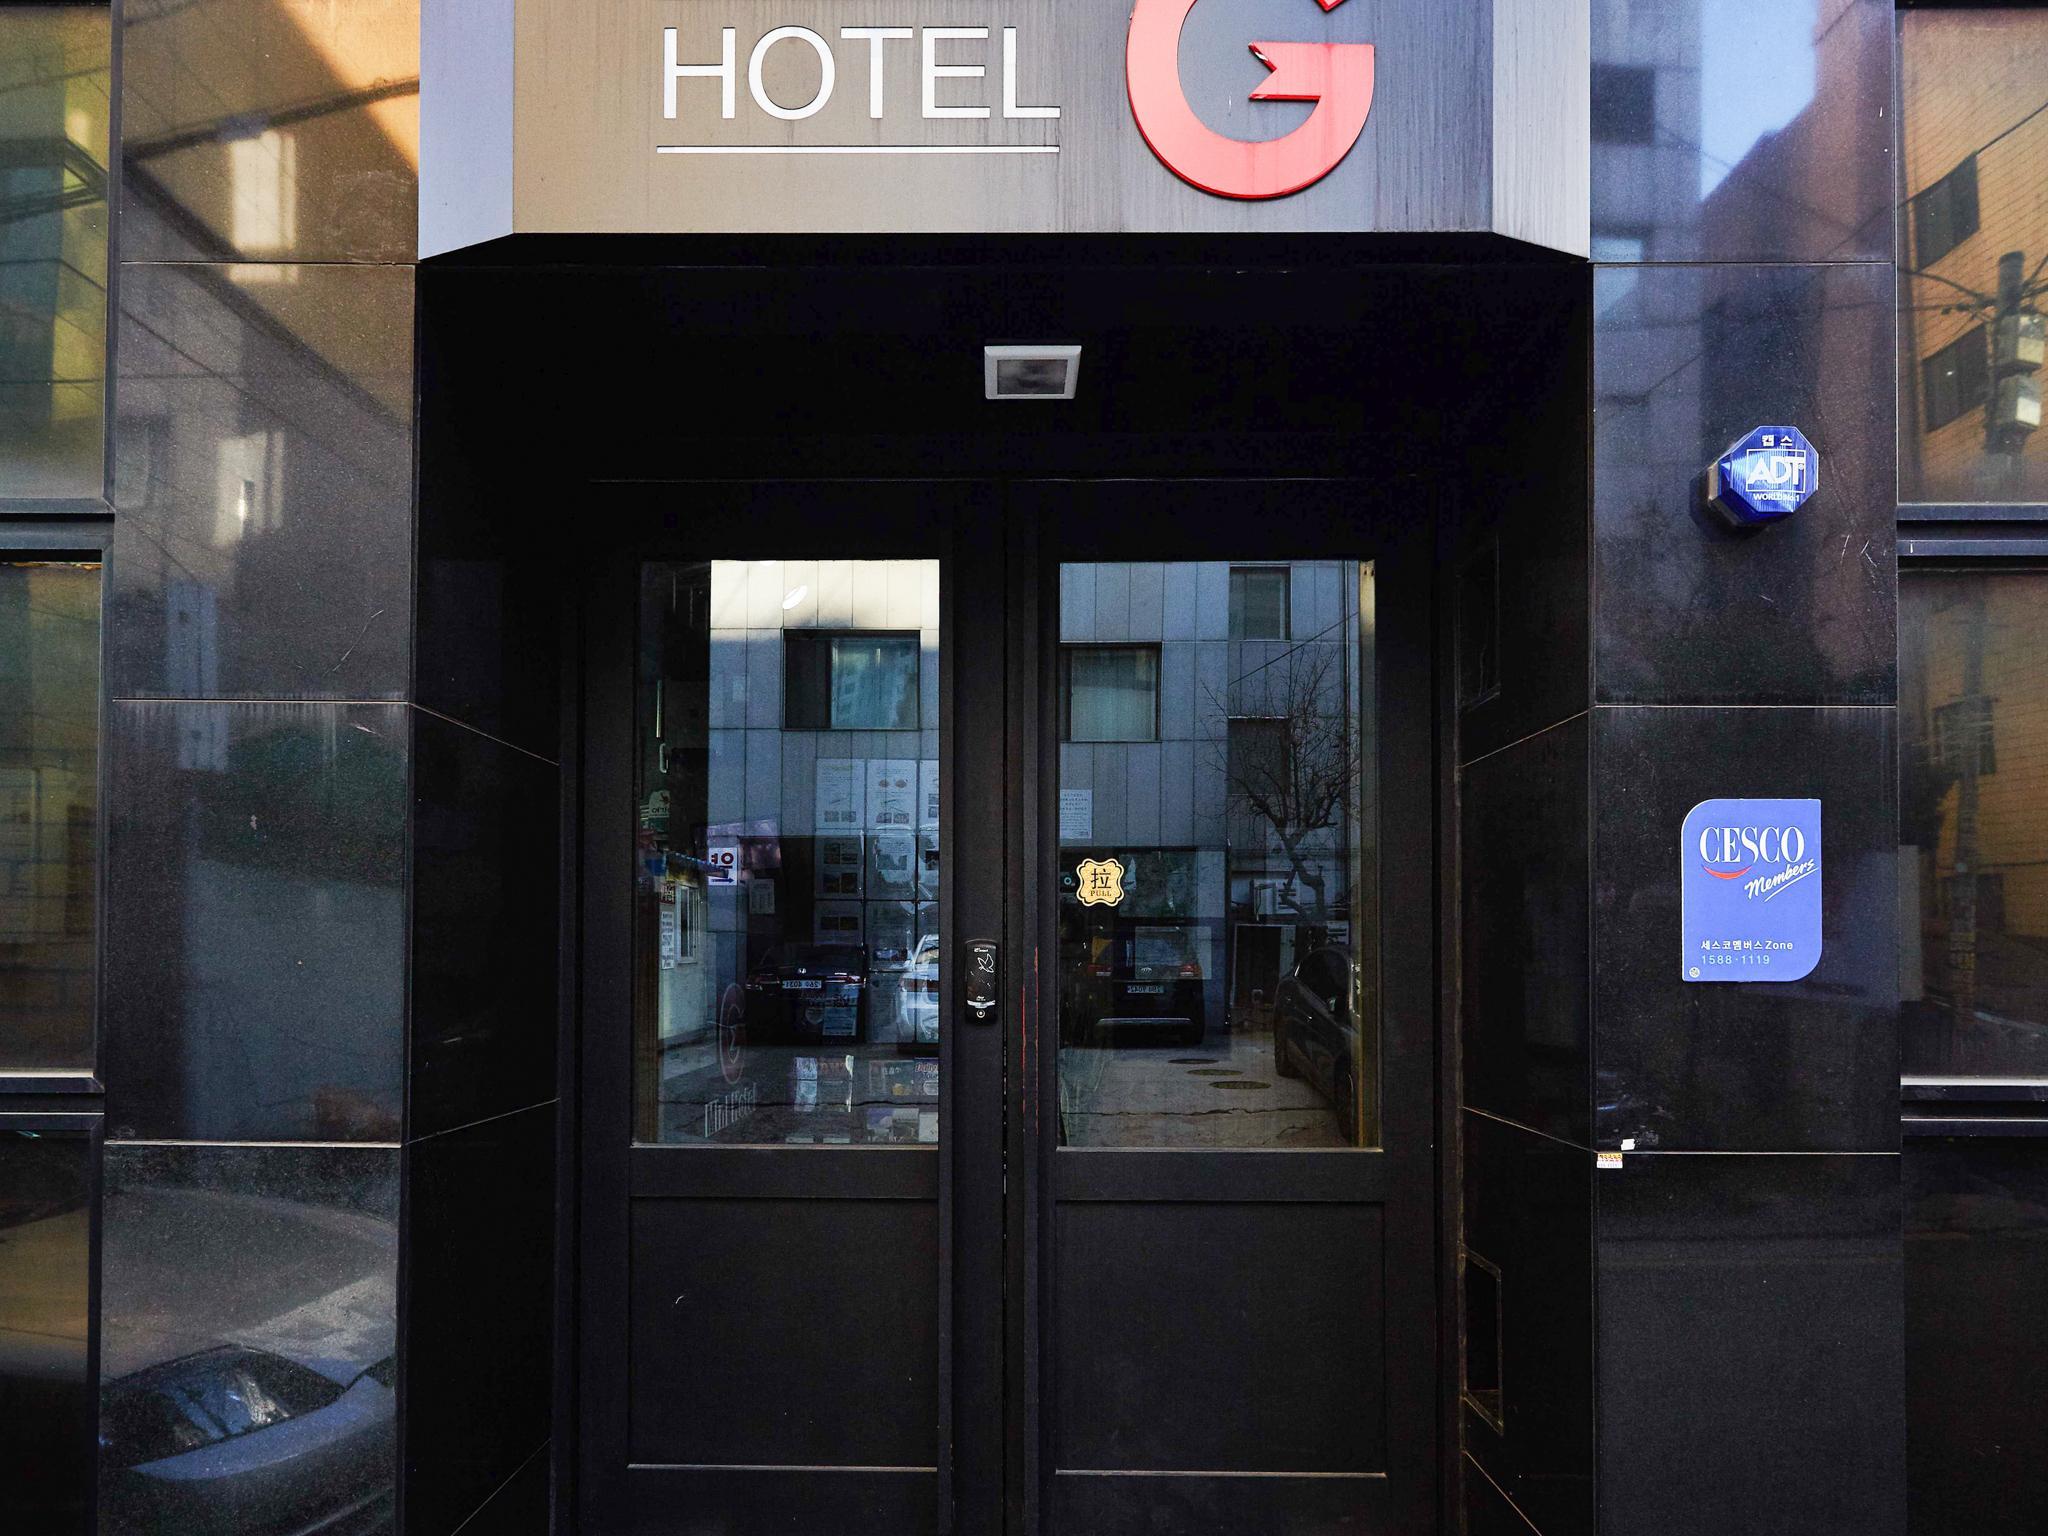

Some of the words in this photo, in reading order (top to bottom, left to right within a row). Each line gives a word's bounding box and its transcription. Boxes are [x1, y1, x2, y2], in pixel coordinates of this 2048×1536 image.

[664, 26, 1061, 120] HOTEL
[1126, 0, 1375, 199] G
[1761, 434, 1793, 447] 캡스
[1747, 455, 1805, 485] ADT
[1753, 492, 1782, 501] WORLD
[1699, 826, 1805, 863] CESCO
[1090, 868, 1112, 889] 拉
[1744, 858, 1816, 899] Members
